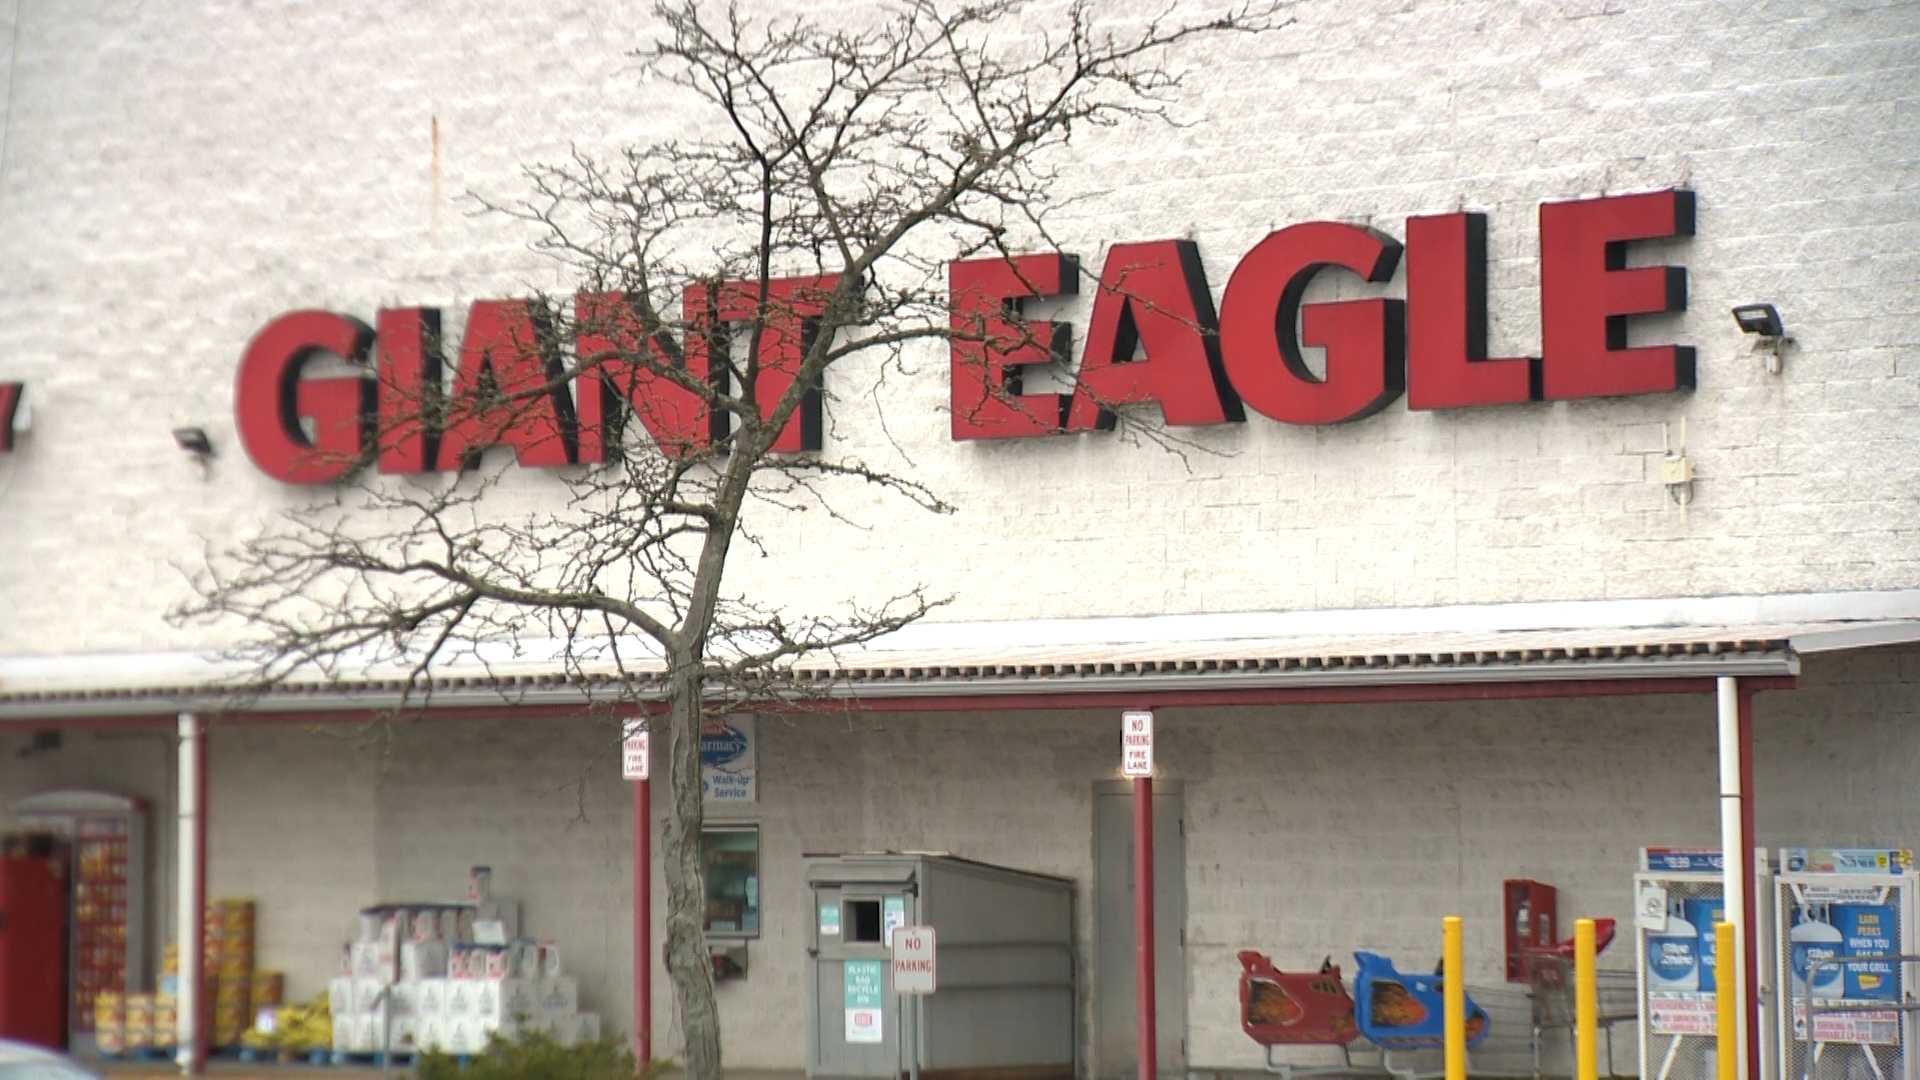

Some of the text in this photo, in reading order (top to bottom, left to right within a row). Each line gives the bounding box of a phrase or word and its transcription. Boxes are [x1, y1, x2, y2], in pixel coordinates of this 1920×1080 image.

[235, 190, 1696, 485] GIANT EAGLE
[1131, 719, 1144, 732] NO
[1125, 735, 1151, 746] PARKING
[700, 740, 742, 754] armacy
[1129, 751, 1146, 759] FIRE
[1127, 760, 1148, 770] LANE
[714, 787, 746, 798] Service
[905, 937, 921, 951] NO
[1849, 938, 1890, 949] WHEN YOU
[847, 965, 877, 975] PLASTIC
[895, 959, 932, 973] PARKING
[1848, 962, 1868, 973] YOUR
[847, 985, 878, 994] RECYCLE
